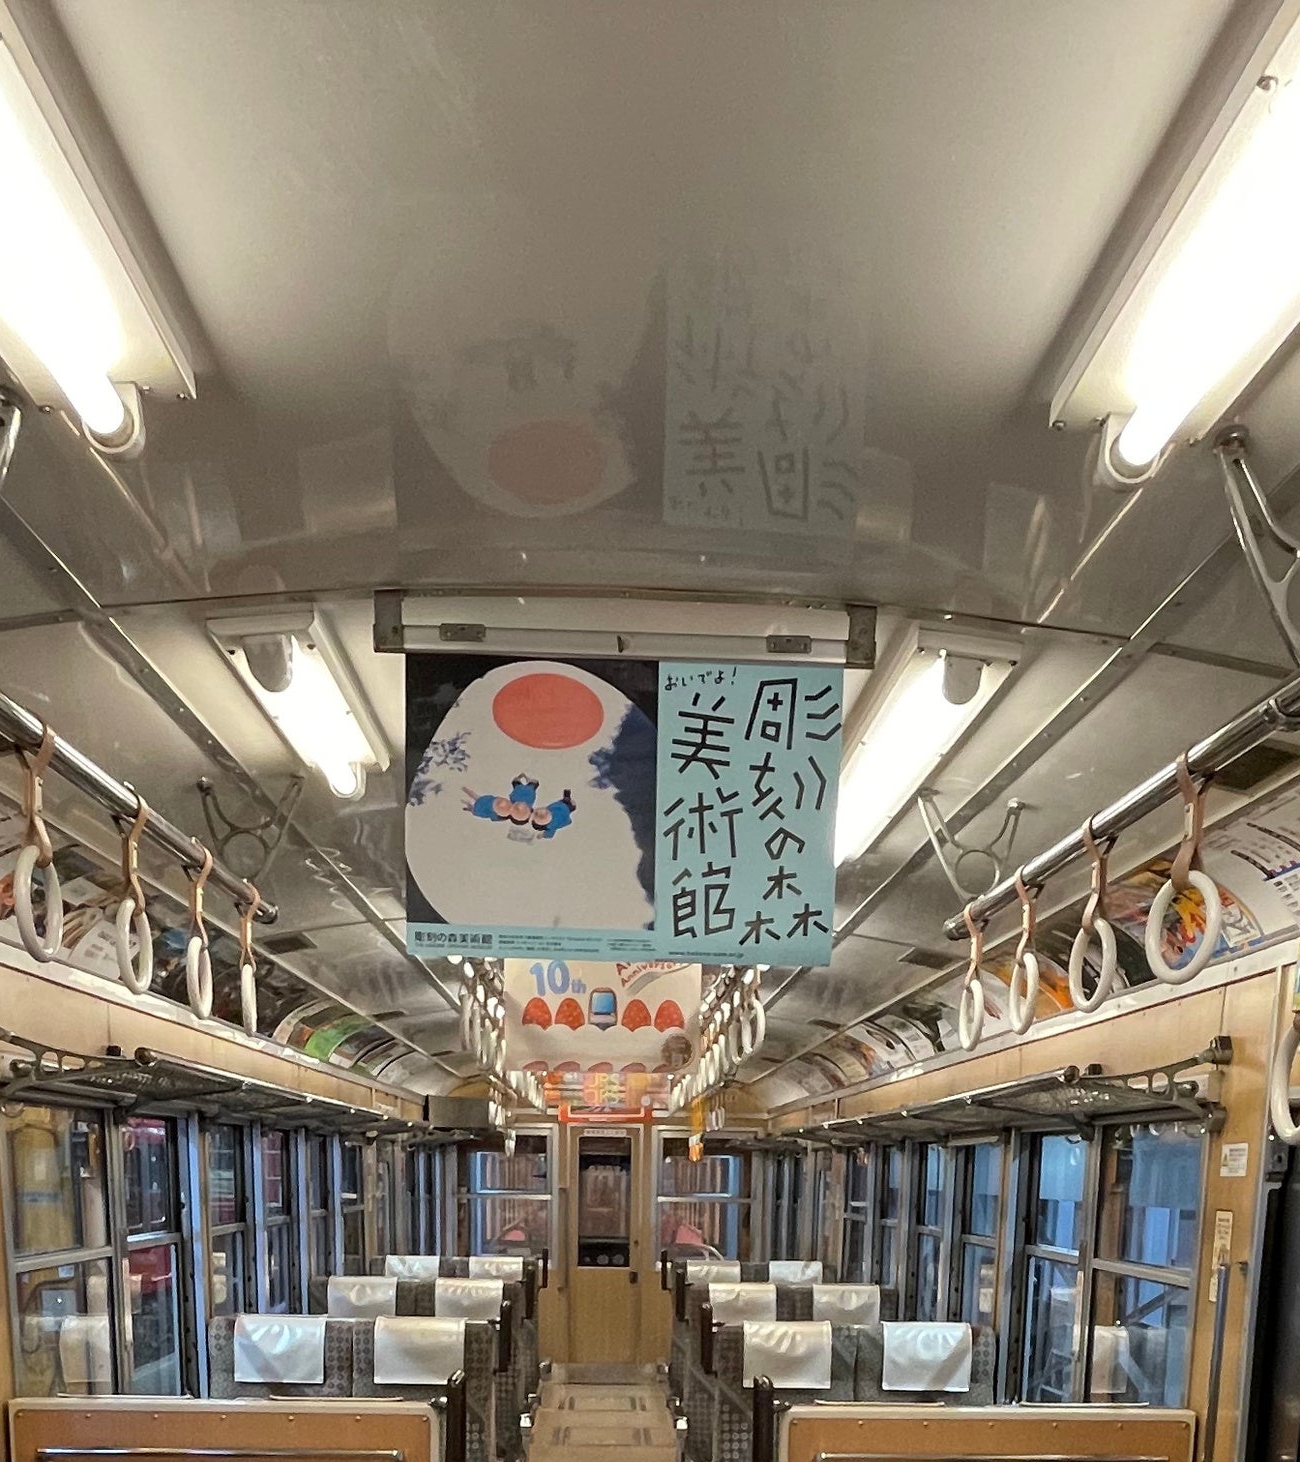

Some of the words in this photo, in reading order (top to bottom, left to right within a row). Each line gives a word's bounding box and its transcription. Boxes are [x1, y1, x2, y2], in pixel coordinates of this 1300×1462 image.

[662, 691, 744, 939] 美術館
[738, 677, 842, 946] 彫刻の森
[529, 960, 587, 997] 10th
